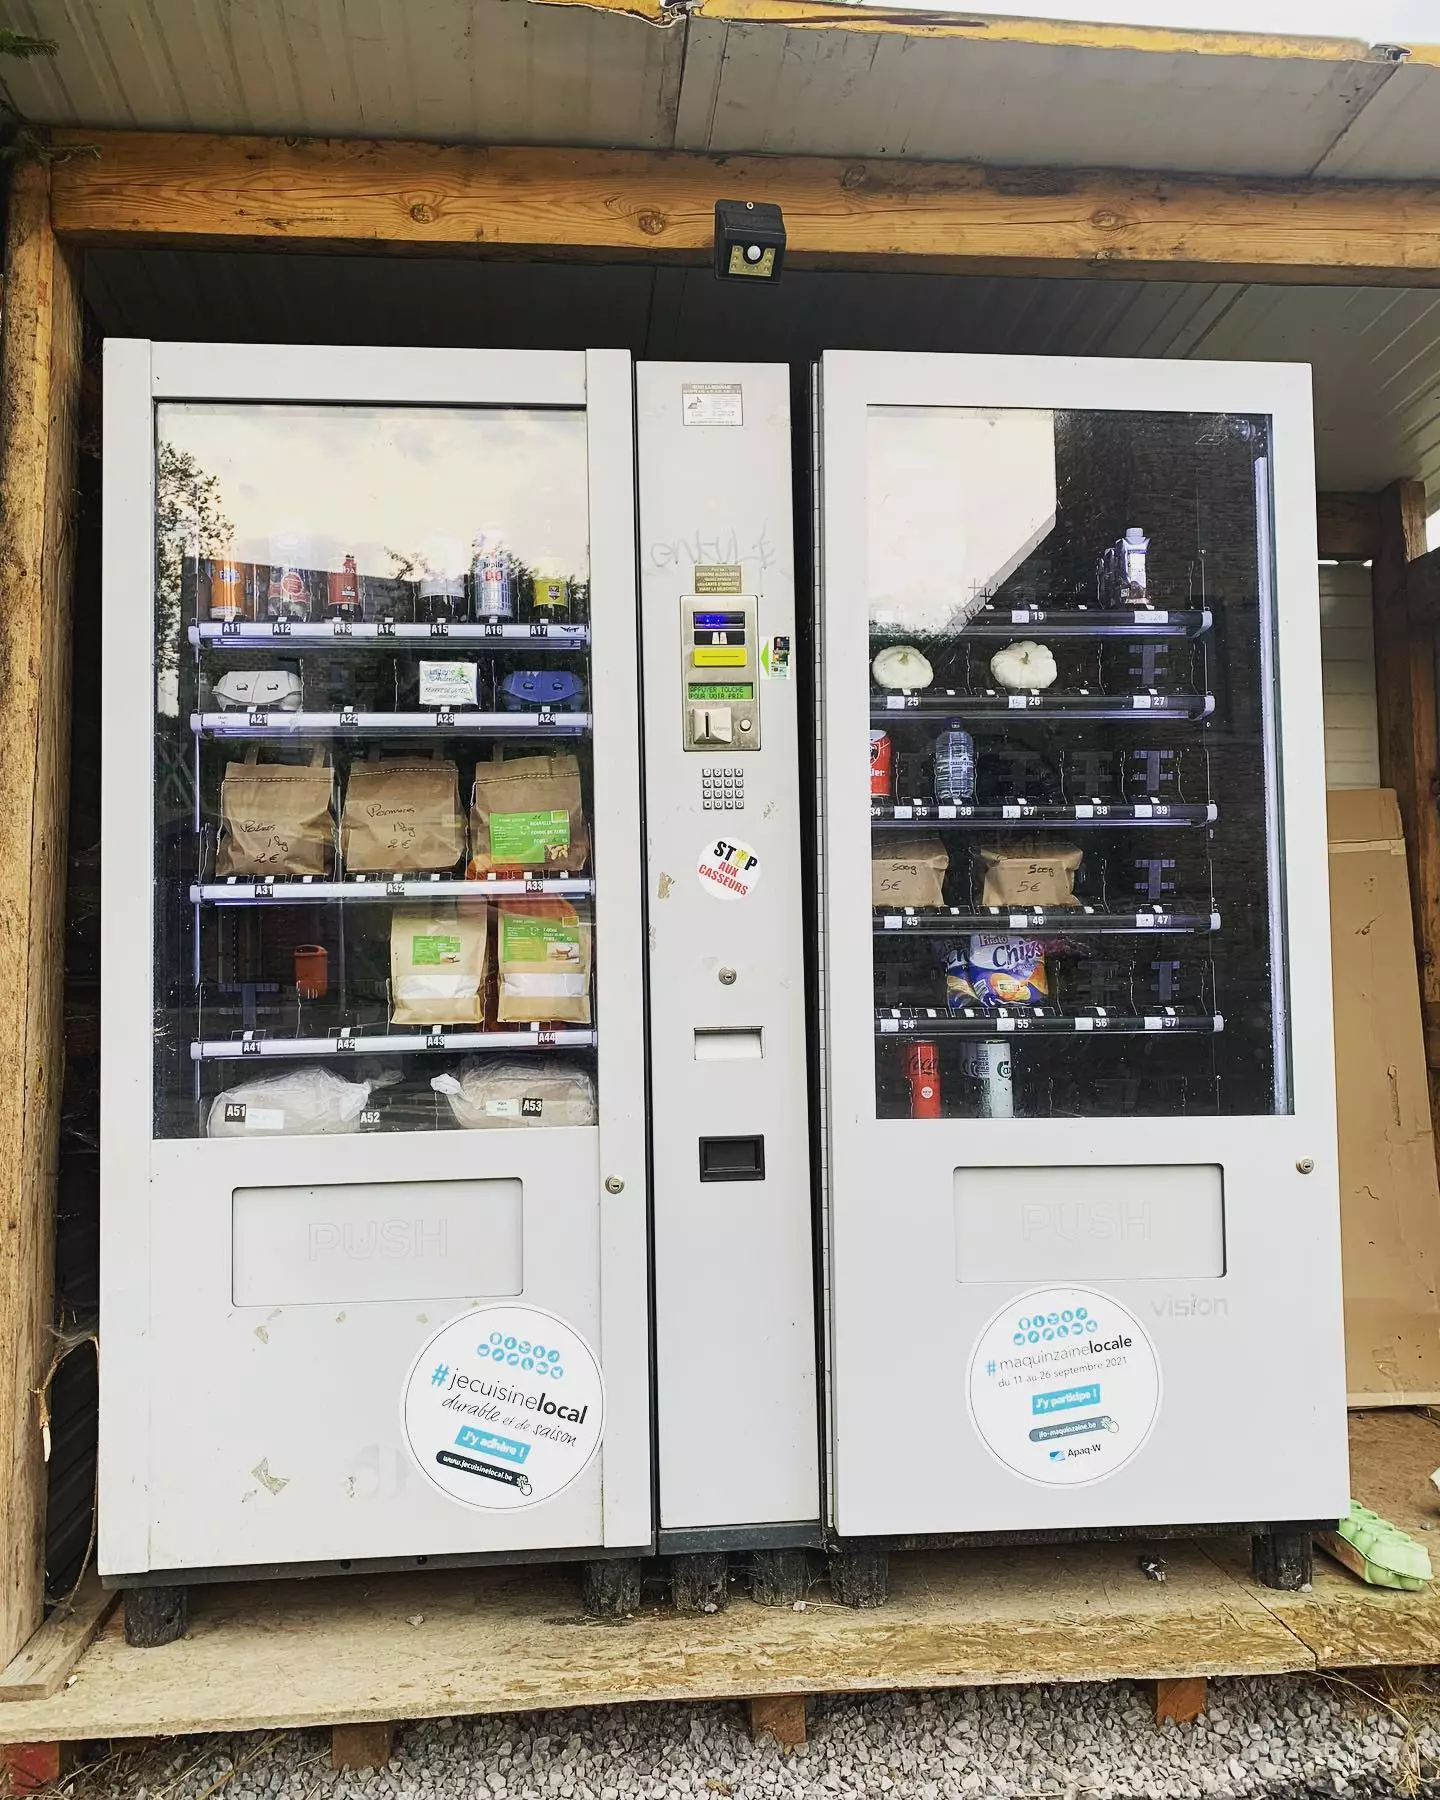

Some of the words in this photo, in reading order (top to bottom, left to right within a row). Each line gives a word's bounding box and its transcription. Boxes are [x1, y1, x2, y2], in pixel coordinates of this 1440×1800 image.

[1033, 611, 1044, 620] 19
[223, 624, 240, 633] A11
[273, 624, 291, 633] A12
[334, 624, 352, 633] A13
[378, 624, 395, 633] A14
[431, 625, 448, 634] A15
[486, 625, 502, 635] A16
[530, 625, 547, 634] A17
[907, 696, 919, 706] 25
[1029, 696, 1041, 706] 26
[1154, 696, 1165, 706] 27
[250, 714, 267, 724] A21
[340, 714, 358, 723] A22
[437, 714, 454, 723] A23
[539, 714, 556, 723] A24
[916, 807, 927, 816] 35
[960, 807, 972, 815] 36
[1023, 807, 1034, 815] 37
[1096, 806, 1108, 815] 38
[1156, 806, 1168, 814] 39
[718, 861, 738, 877] AUX
[698, 864, 749, 895] CASSEURS
[255, 885, 273, 895] A31
[387, 883, 405, 893] A32
[526, 881, 543, 891] A33
[906, 917, 918, 926] 45
[1032, 916, 1044, 925] 46
[1157, 915, 1168, 924] 47
[992, 940, 1043, 968] Chips
[902, 1020, 914, 1029] 54
[1017, 1019, 1028, 1028] 55
[1095, 1018, 1107, 1027] 56
[1165, 1018, 1176, 1027] 57
[427, 1036, 444, 1046] A43
[538, 1033, 555, 1042] A44
[243, 1043, 261, 1053] A41
[337, 1039, 355, 1049] A42
[523, 1100, 542, 1111] A53
[227, 1105, 246, 1117] A51
[360, 1112, 379, 1123] A52
[1022, 1201, 1151, 1241] PUSH
[308, 1217, 449, 1261] PUSH
[1151, 1294, 1228, 1317] vision
[986, 1335, 1133, 1377] #maquinzainelocale
[998, 1377, 1011, 1388] du
[1013, 1375, 1022, 1384] 11
[1026, 1375, 1037, 1383] au
[1040, 1371, 1051, 1380] 26
[1053, 1361, 1103, 1379] septembre
[1105, 1356, 1128, 1368] 2021
[431, 1363, 588, 1425] #jecuisinelocal
[1036, 1399, 1049, 1409] J'y
[1051, 1392, 1091, 1407] participe
[442, 1394, 500, 1422] durable
[502, 1415, 515, 1425] et
[515, 1418, 530, 1431] de
[533, 1425, 577, 1448] saison
[463, 1431, 479, 1445] J'y
[1067, 1444, 1101, 1458] Apaq-W
[443, 1454, 513, 1482] www.jecuisinelocal.be
